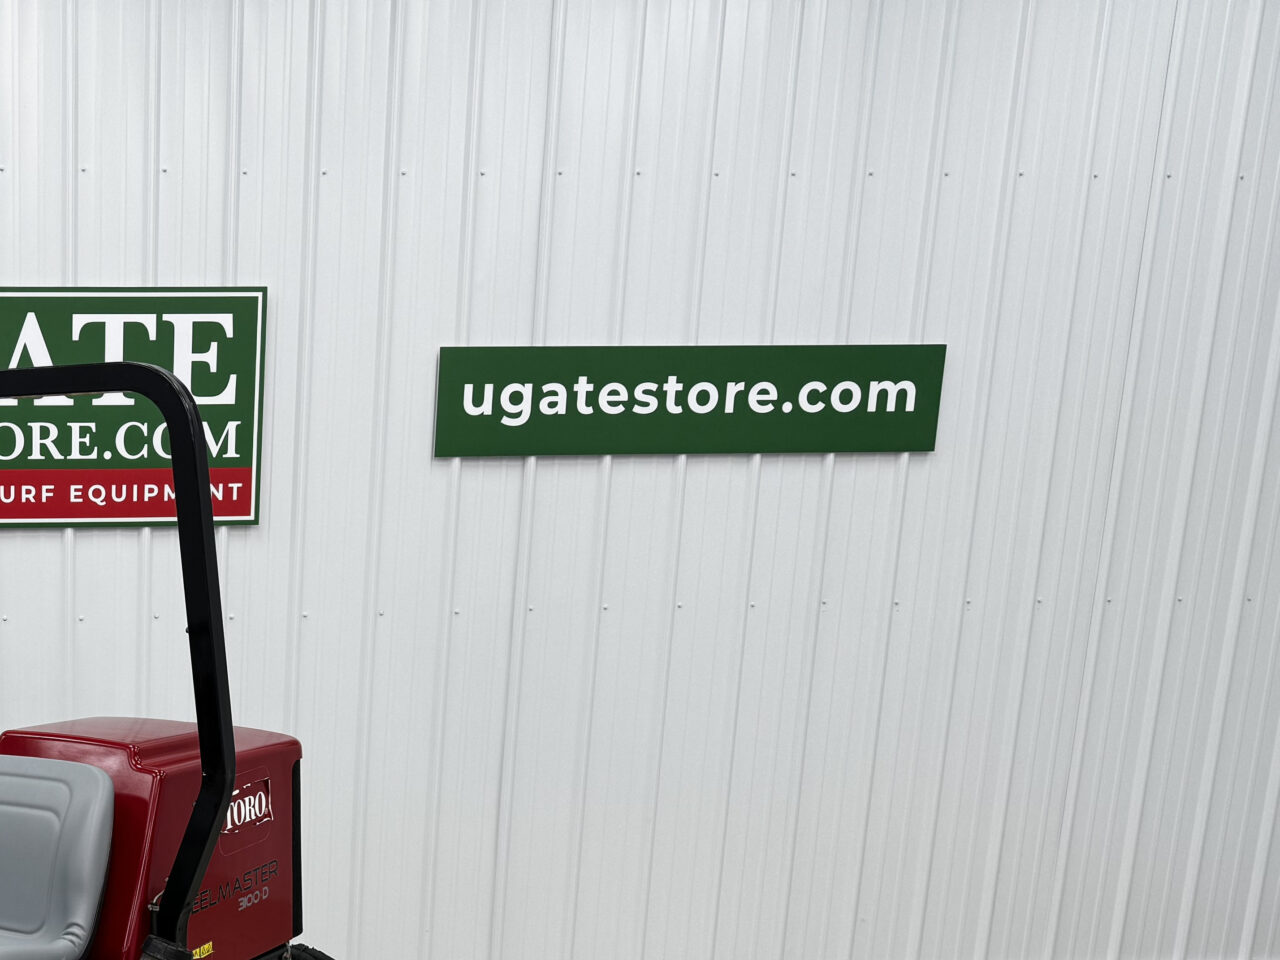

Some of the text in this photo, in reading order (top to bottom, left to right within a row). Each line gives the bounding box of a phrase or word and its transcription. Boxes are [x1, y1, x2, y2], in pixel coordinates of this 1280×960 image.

[463, 375, 917, 427] ugatestore.com
[69, 482, 243, 506] EQUIPMNT
[226, 791, 266, 830] TORO
[192, 859, 279, 914] EELMASTER
